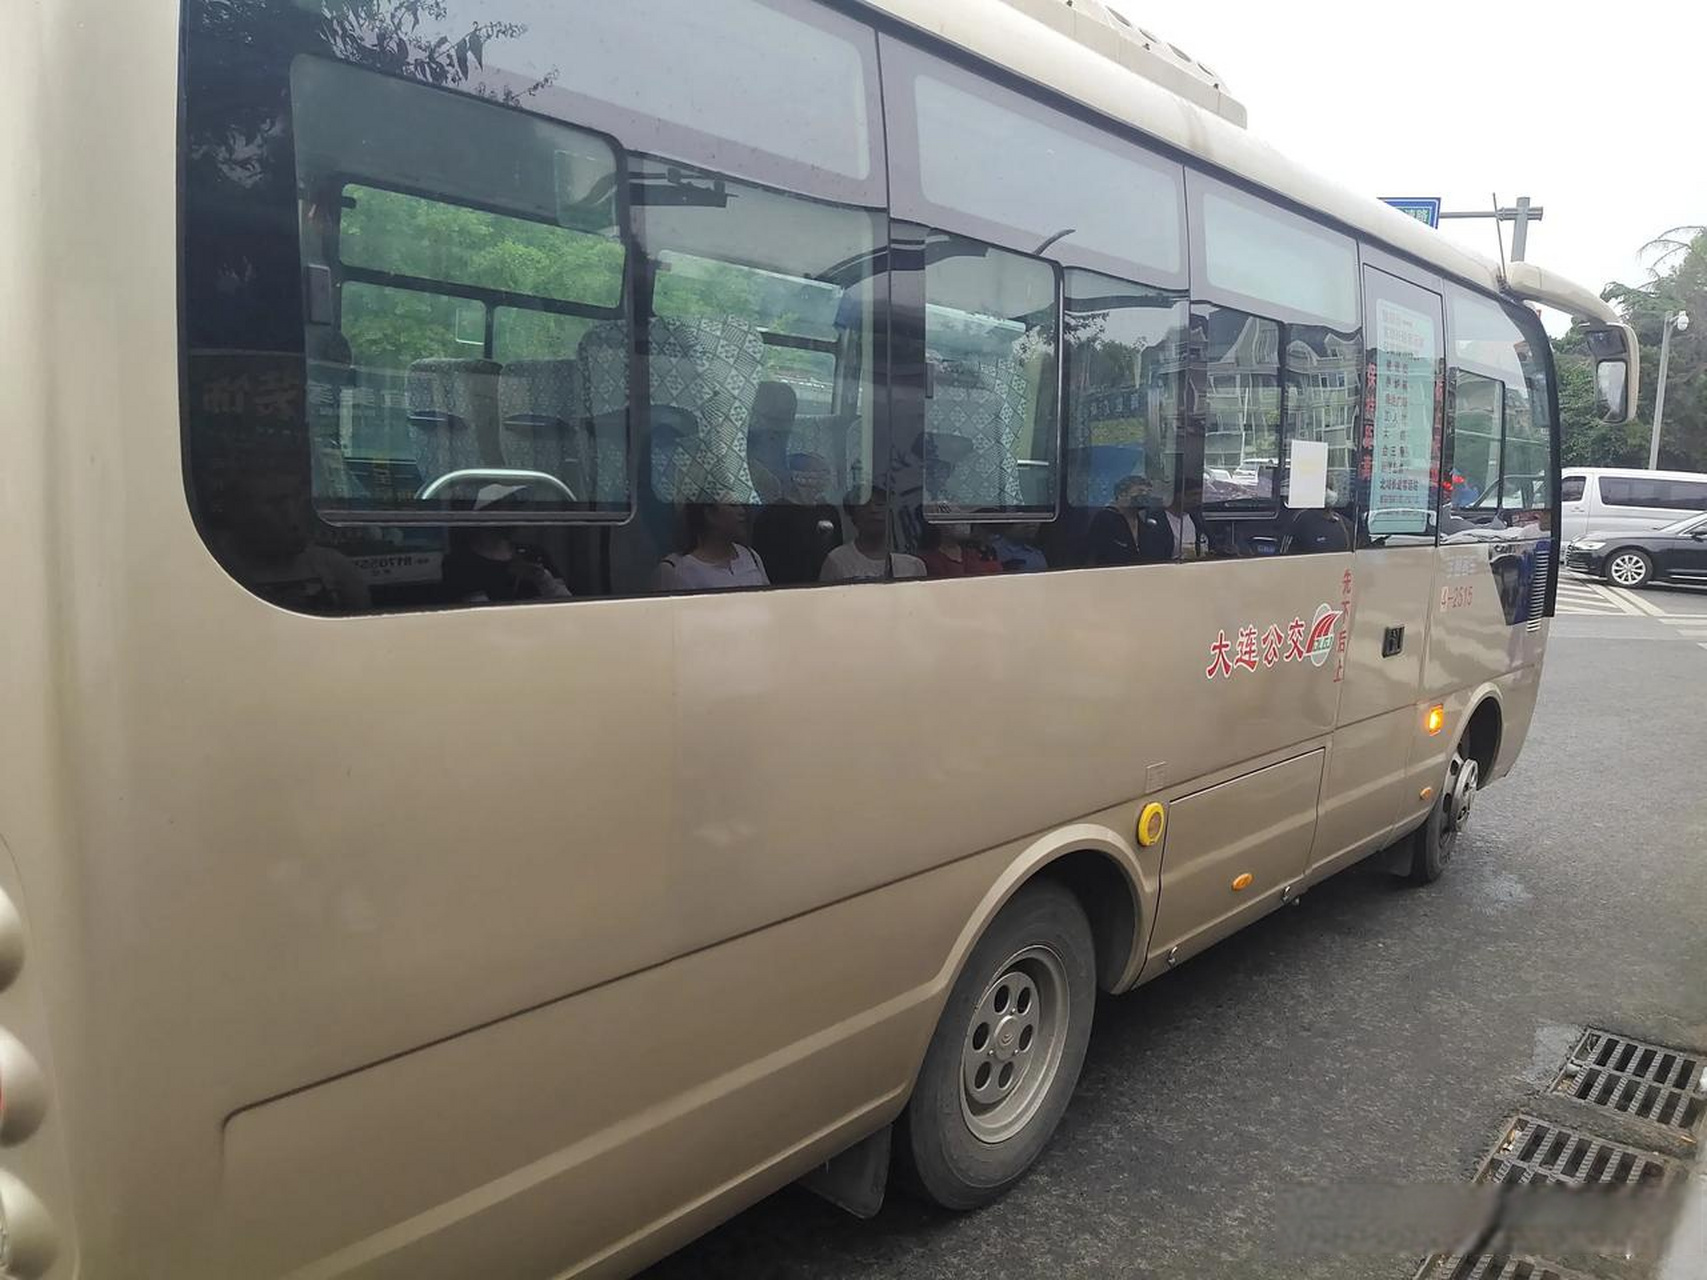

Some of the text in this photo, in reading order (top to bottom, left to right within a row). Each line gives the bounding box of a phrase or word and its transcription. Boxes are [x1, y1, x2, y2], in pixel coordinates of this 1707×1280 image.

[1206, 617, 1307, 680] 大连公交
[1333, 568, 1352, 683] 先下后上
